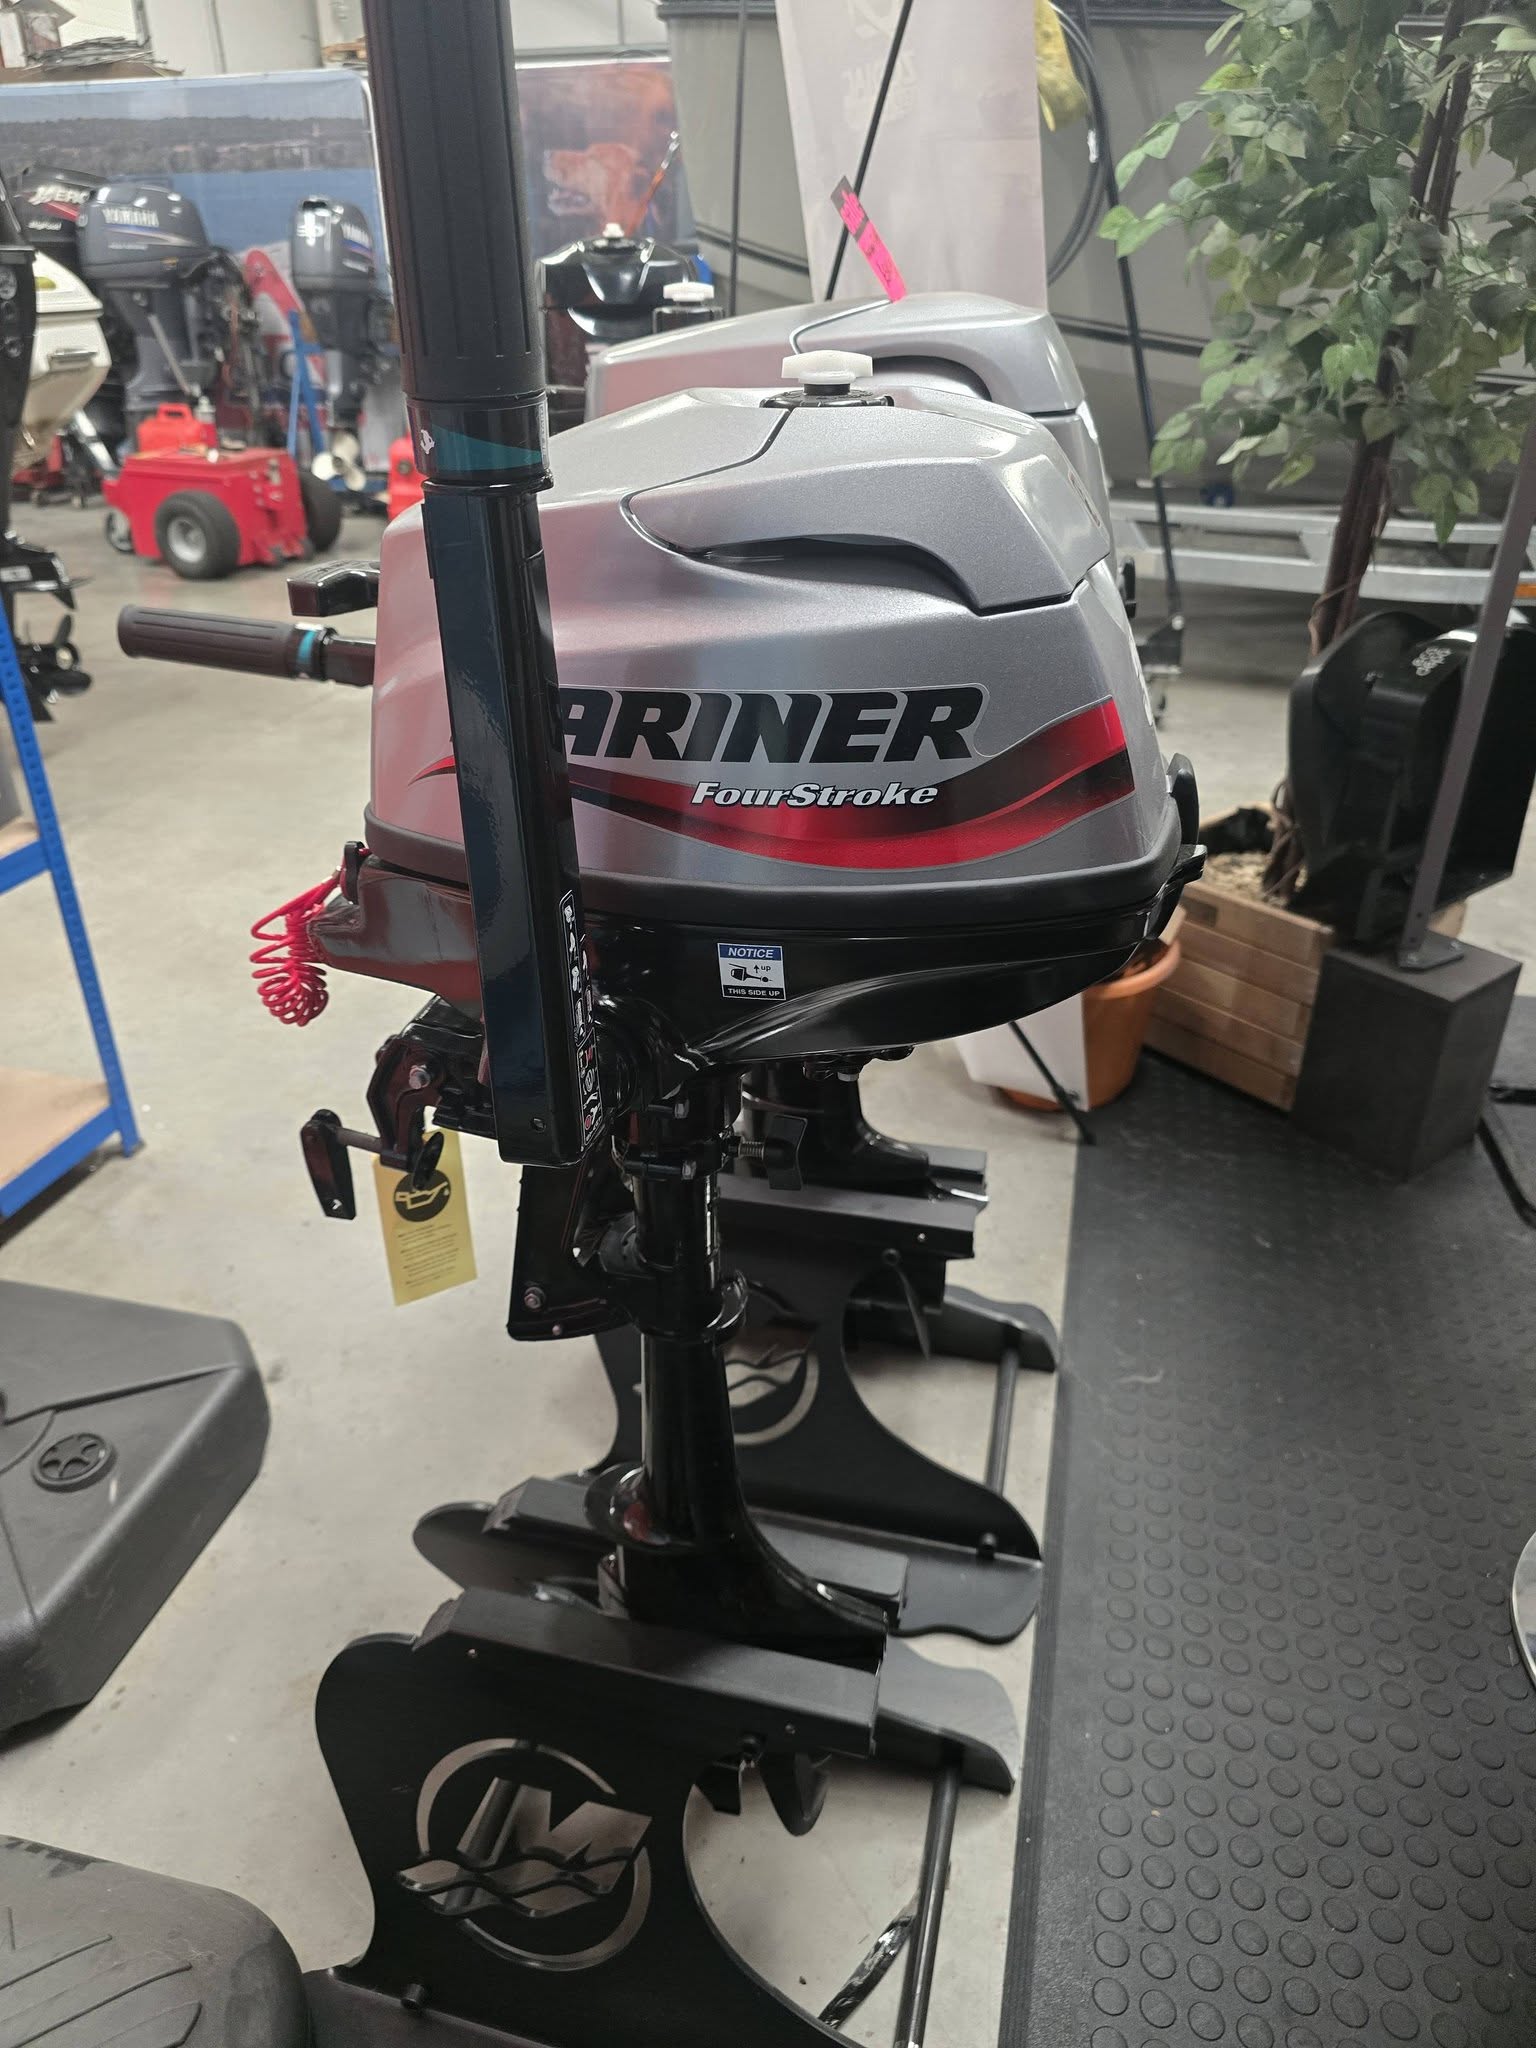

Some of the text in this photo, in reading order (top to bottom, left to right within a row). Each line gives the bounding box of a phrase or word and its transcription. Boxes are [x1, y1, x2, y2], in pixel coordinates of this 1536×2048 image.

[558, 685, 983, 763] ARINER
[691, 781, 939, 808] FourStroke
[728, 947, 774, 958] NOTICE
